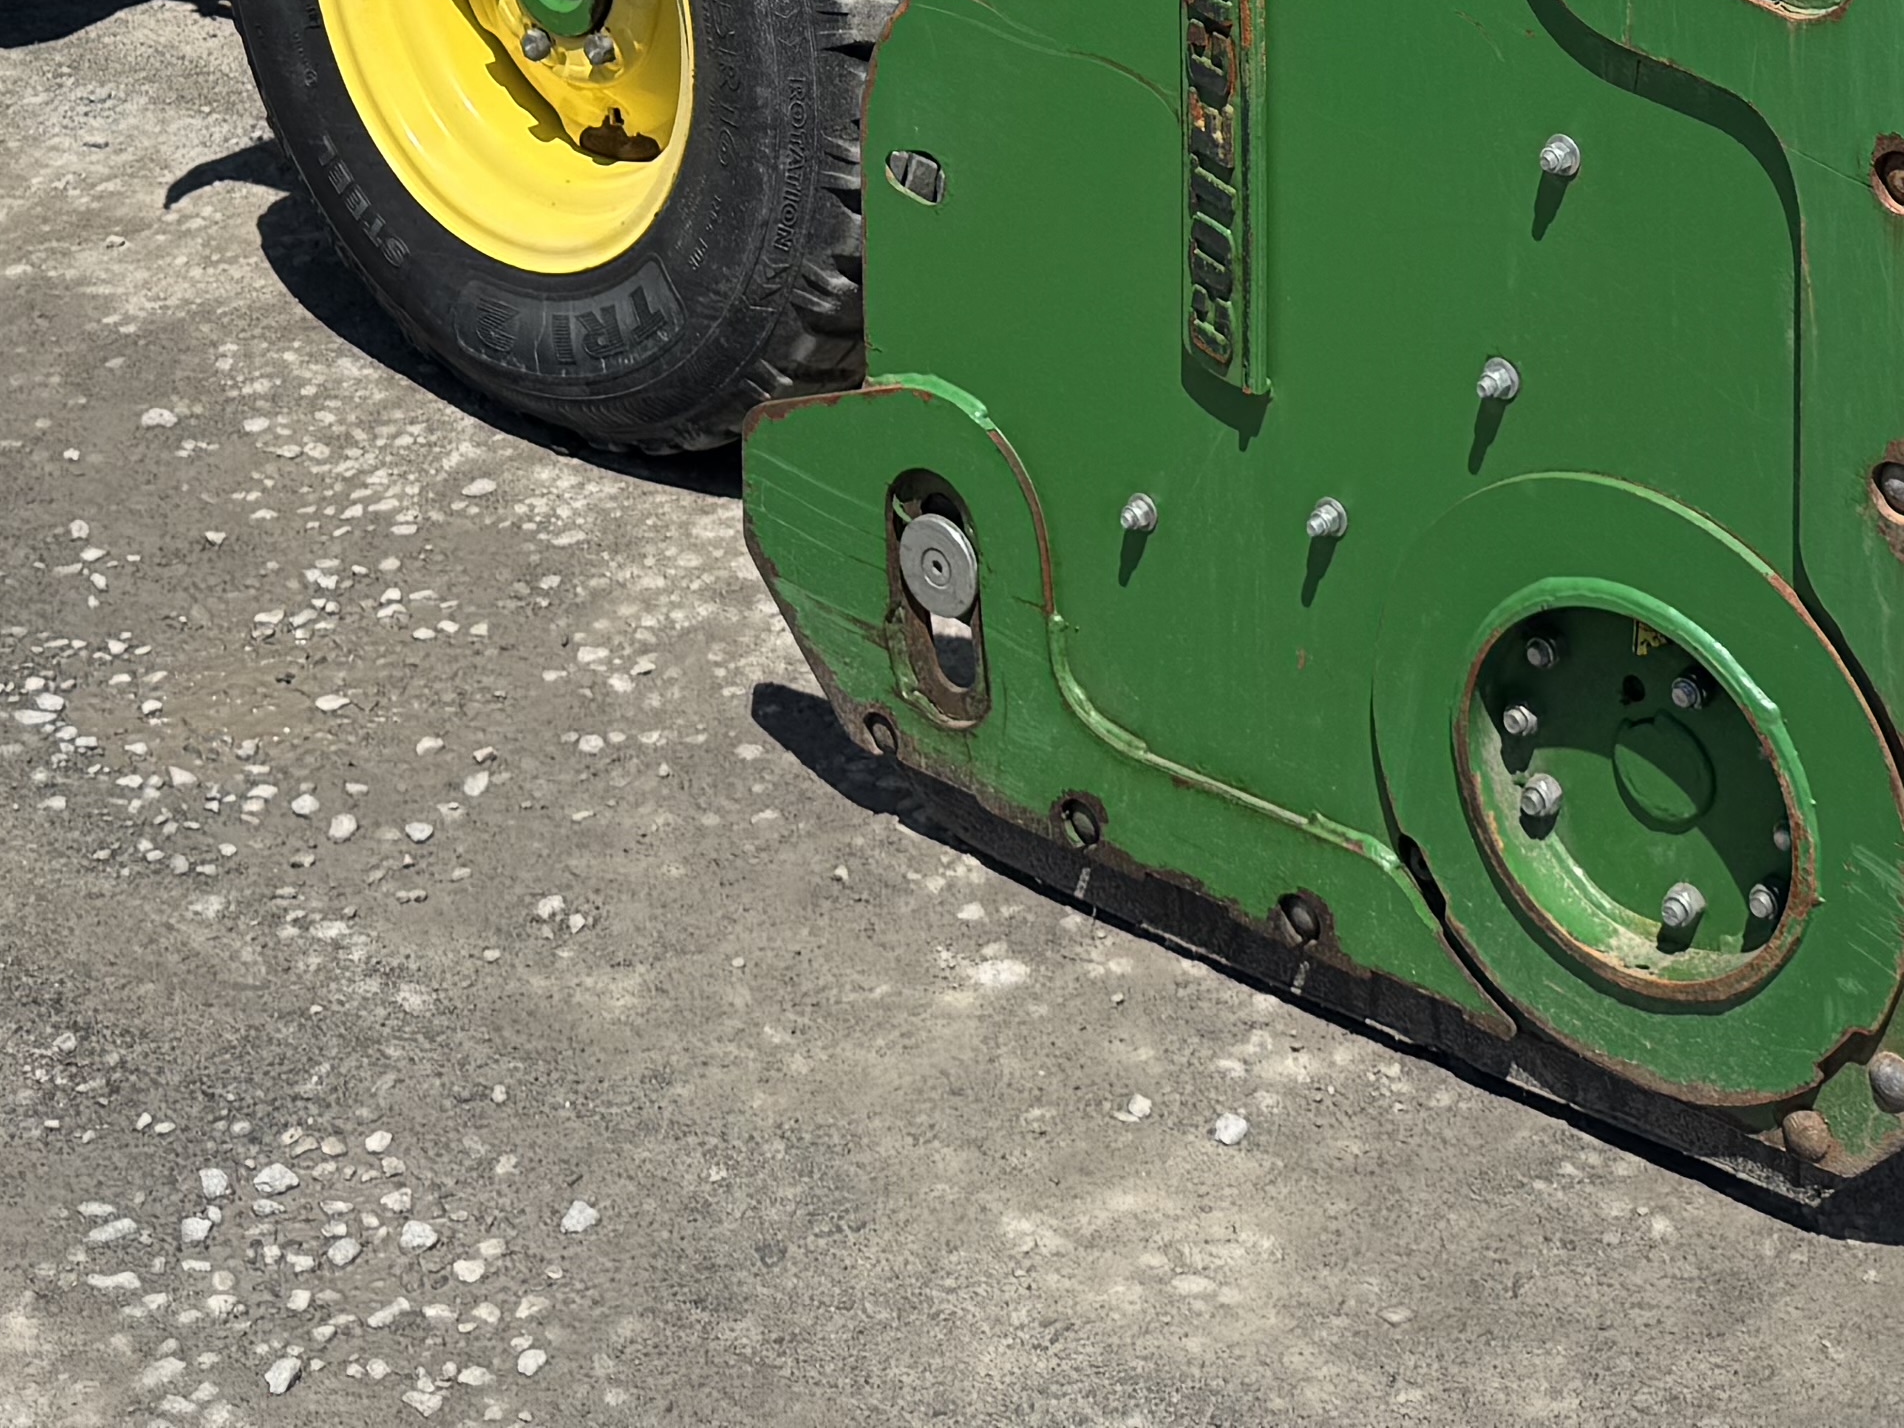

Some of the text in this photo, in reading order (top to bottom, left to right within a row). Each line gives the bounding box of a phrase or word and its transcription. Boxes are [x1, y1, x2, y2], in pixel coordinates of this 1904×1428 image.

[317, 134, 412, 269] STEEL
[474, 285, 669, 367] TRI 2
